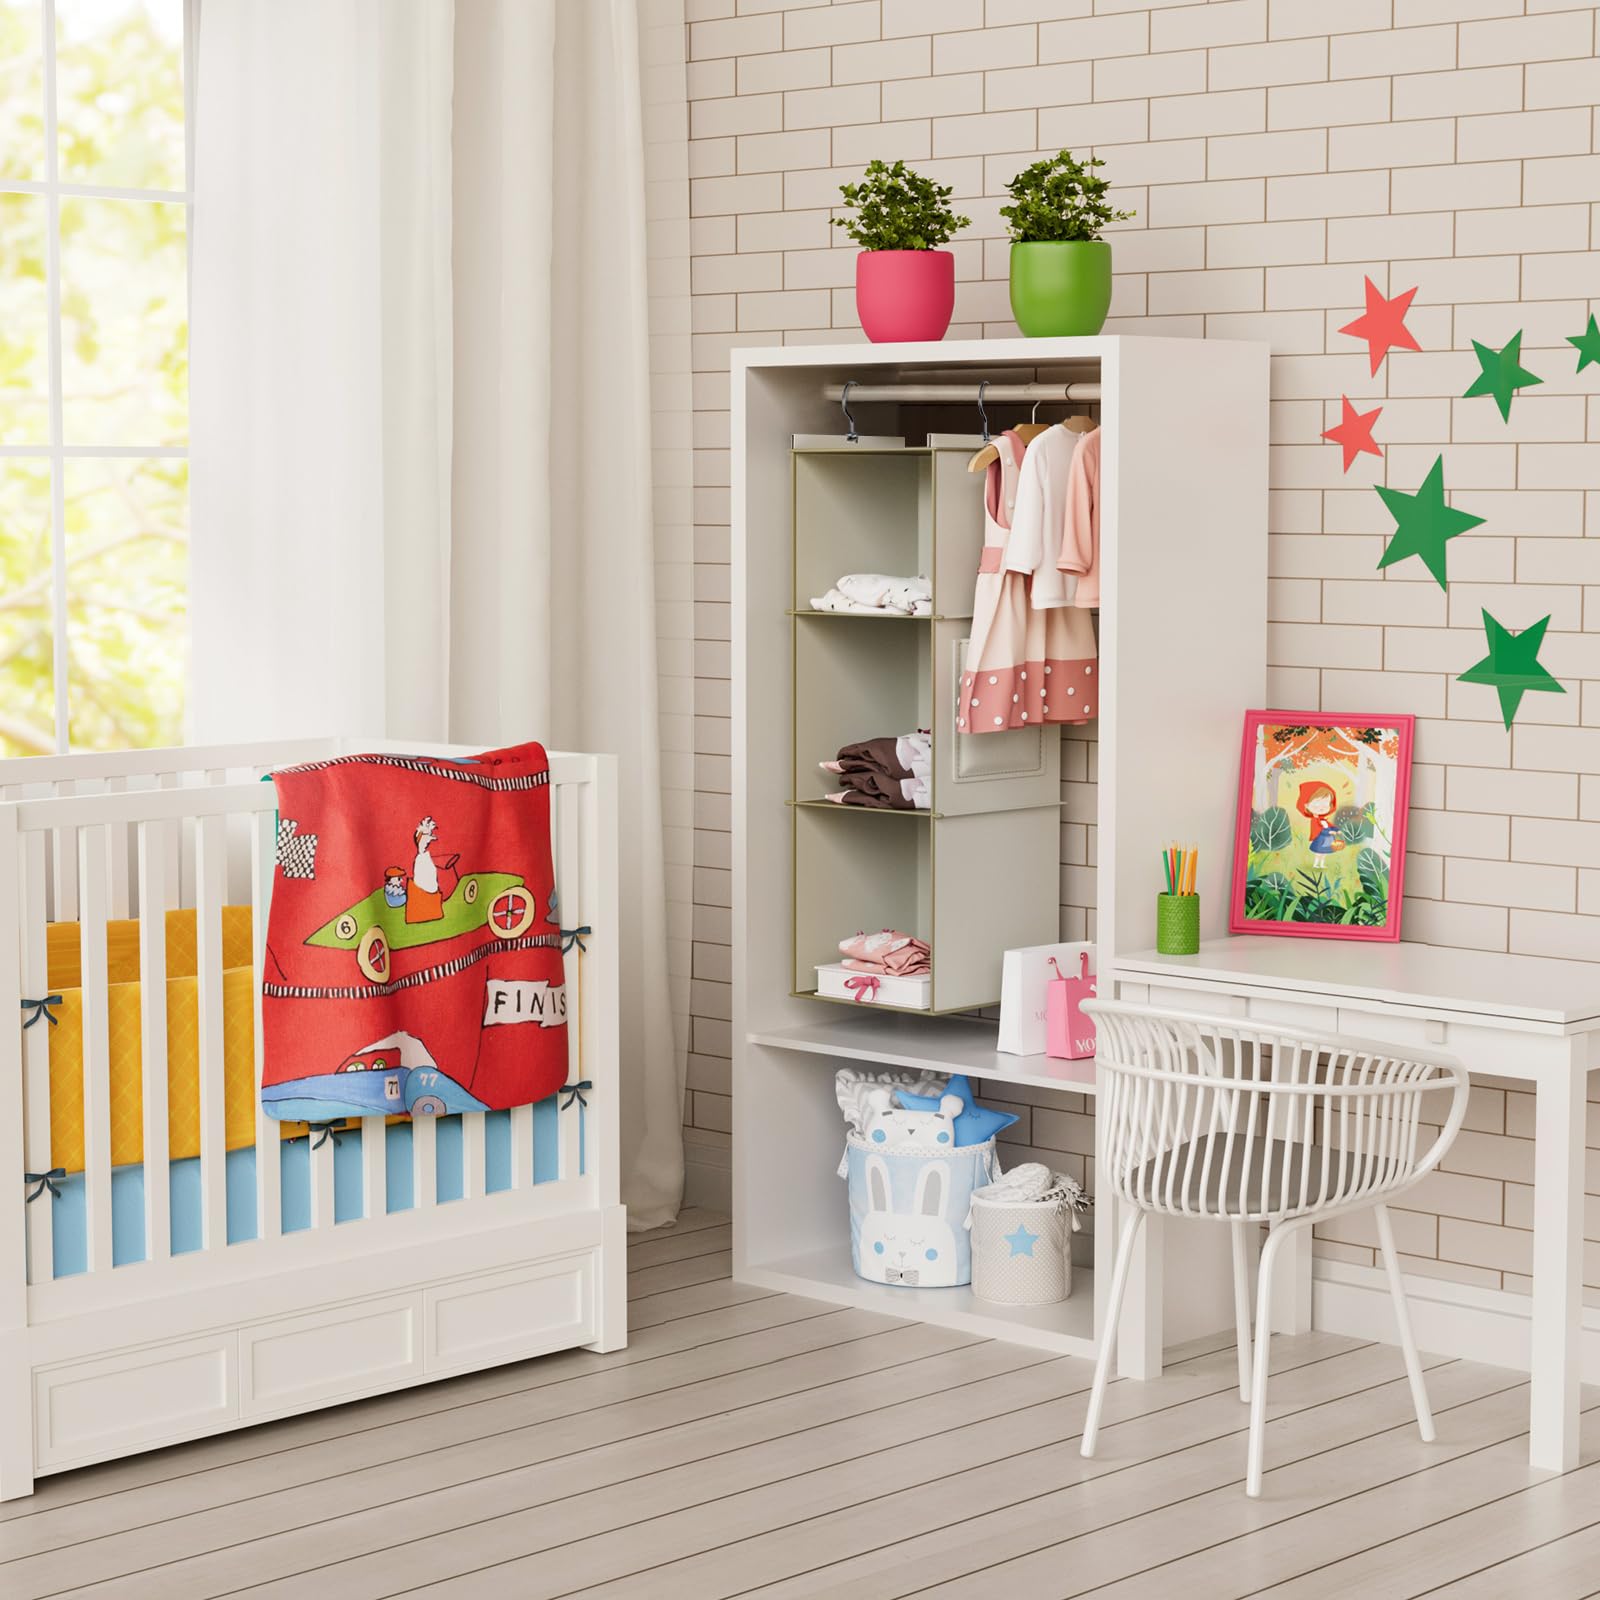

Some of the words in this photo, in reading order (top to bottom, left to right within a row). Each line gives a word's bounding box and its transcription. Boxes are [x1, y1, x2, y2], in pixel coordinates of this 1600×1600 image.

[340, 921, 351, 934] 6
[1075, 1036, 1097, 1054] MO
[419, 1072, 439, 1088] 77
